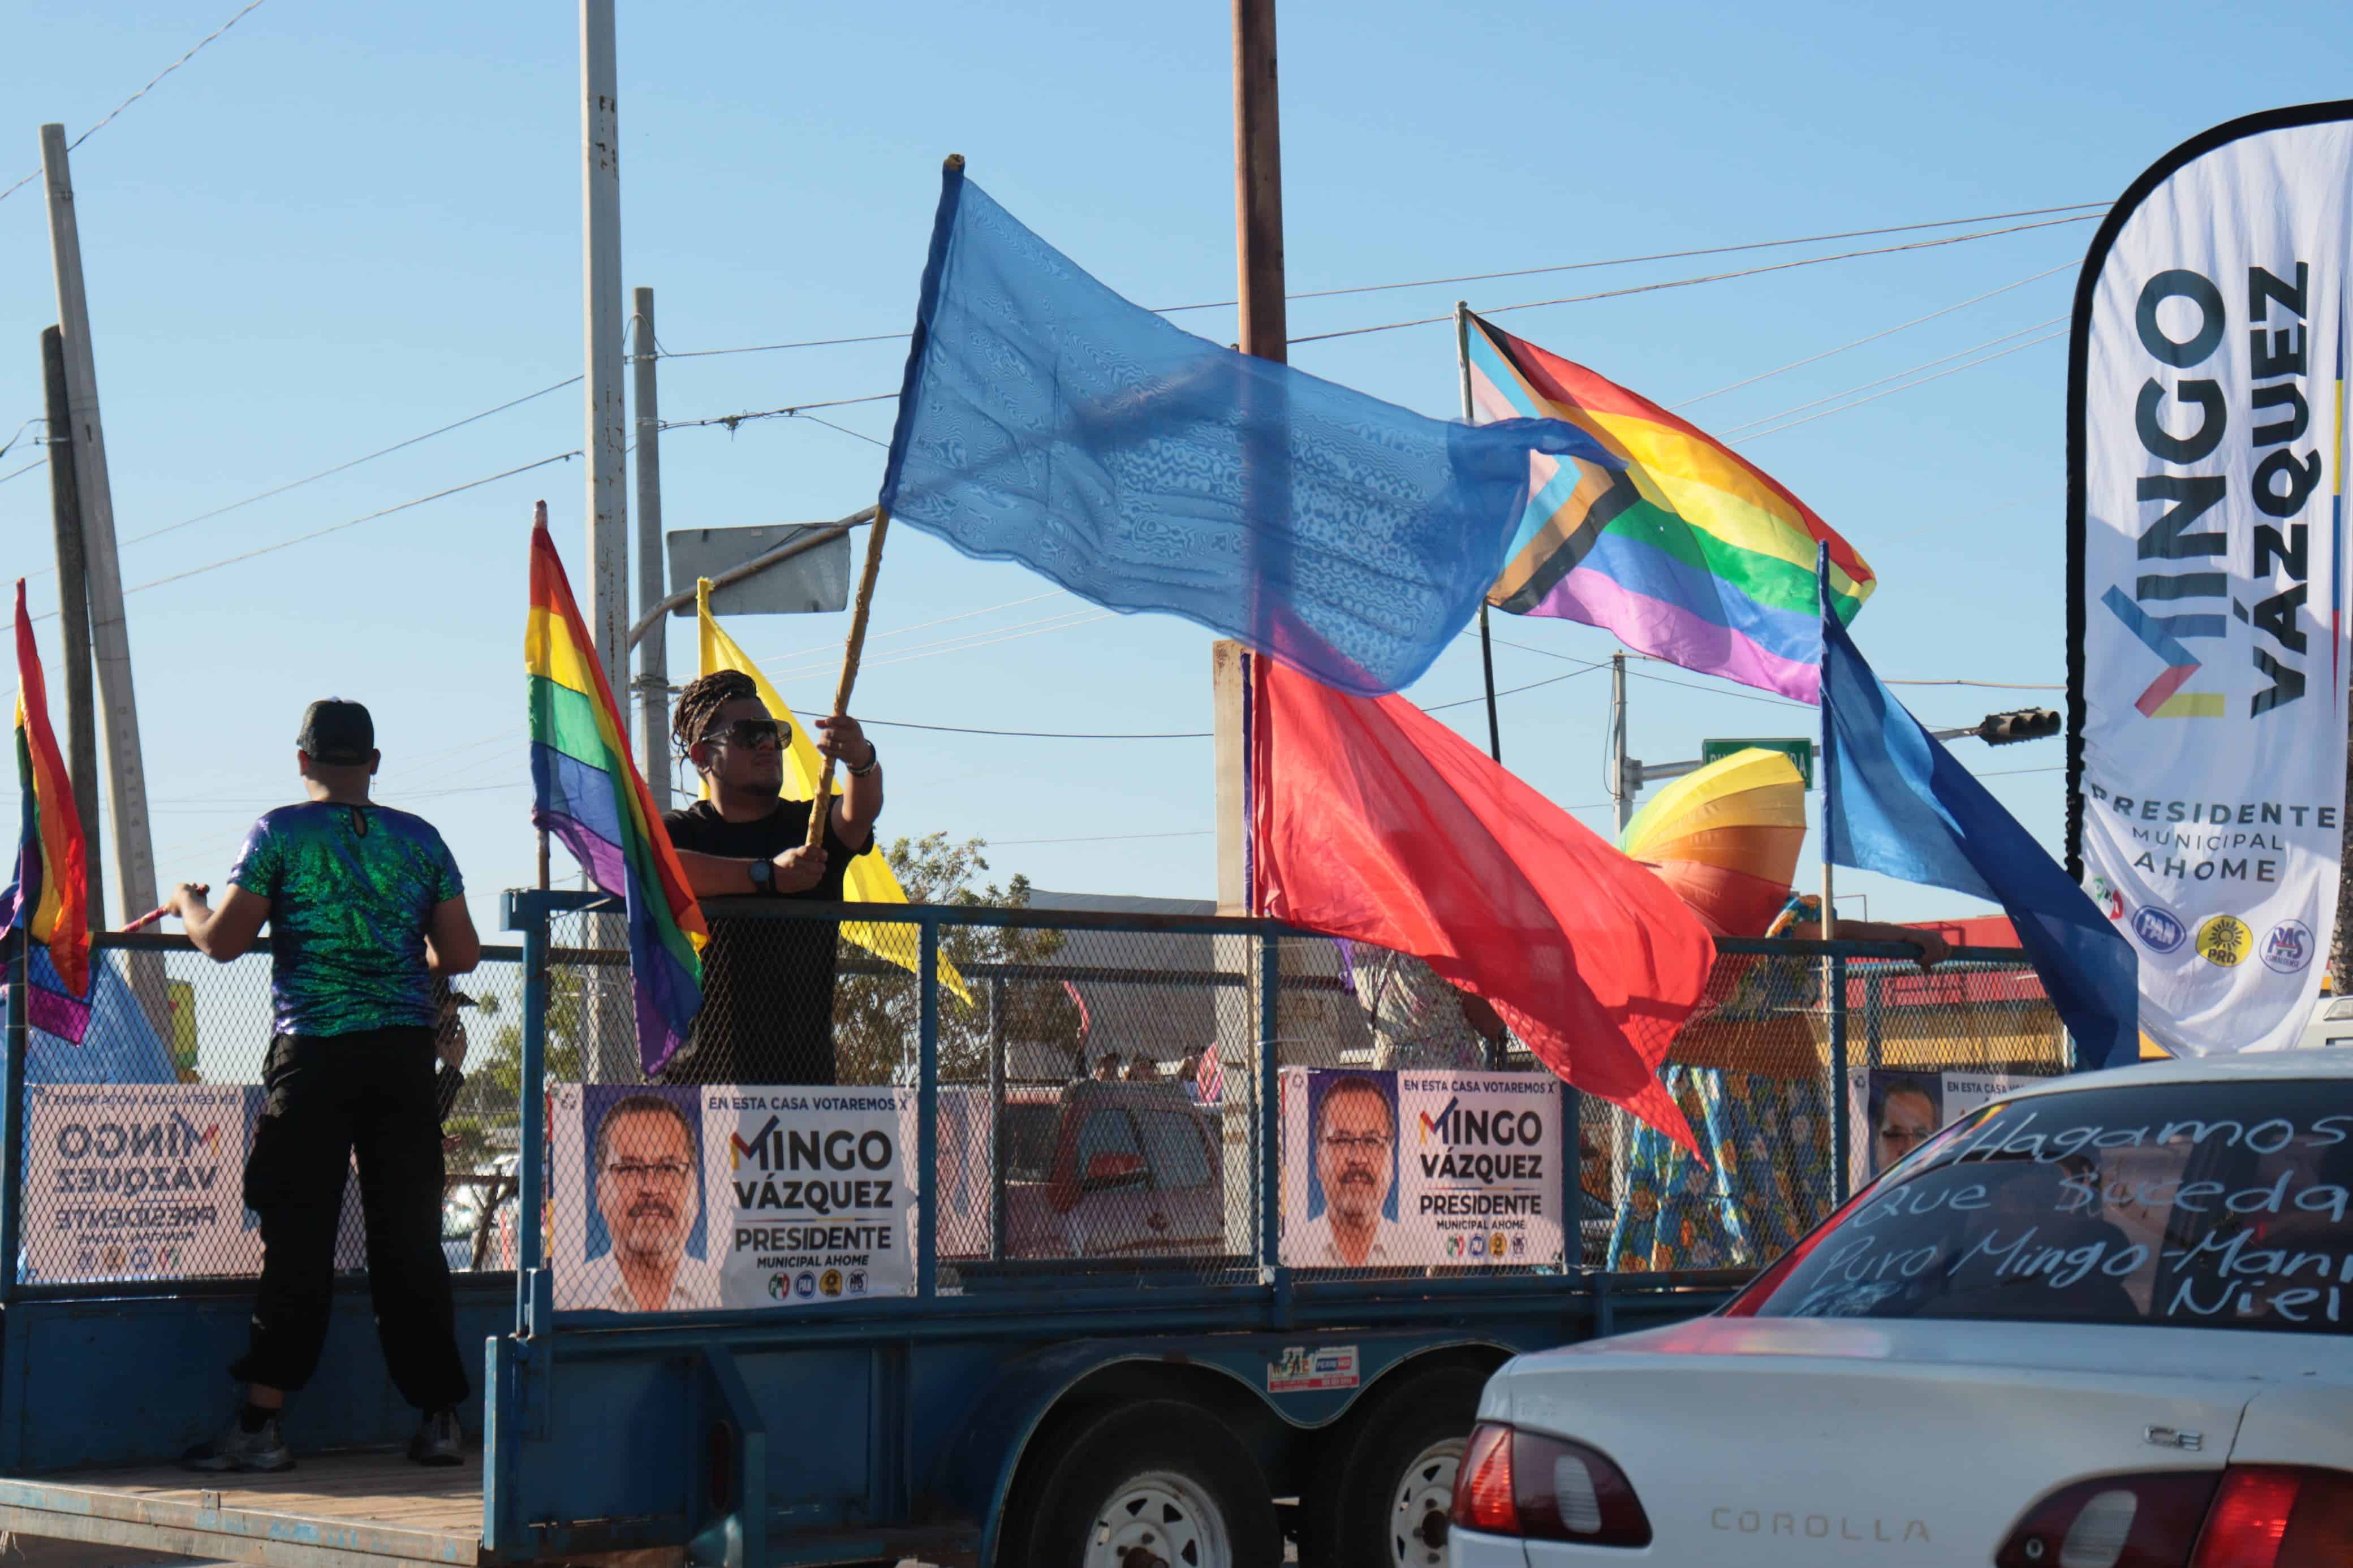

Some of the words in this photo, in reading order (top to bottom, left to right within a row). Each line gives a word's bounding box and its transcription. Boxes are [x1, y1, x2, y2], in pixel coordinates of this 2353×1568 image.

[2101, 269, 2227, 718] MINGO
[2233, 261, 2321, 719] VÁZQUEZ
[2092, 784, 2336, 828] PRESIDENTE
[2132, 827, 2283, 850] MUNICIPAL
[2134, 851, 2276, 883] AHOME
[2141, 913, 2175, 946] PAN
[2208, 948, 2236, 964] PRD
[1403, 1080, 1419, 1091] EN
[1422, 1080, 1448, 1091] ESTA
[1451, 1081, 1481, 1092] CASA
[1483, 1082, 1545, 1094] VOTAREMOS
[1947, 1082, 1959, 1092] EN
[1962, 1082, 1981, 1093] ESTA
[1984, 1083, 2007, 1094] CASA
[709, 1097, 729, 1109] EN
[733, 1097, 767, 1109] ESTA
[771, 1097, 809, 1110] CASA
[813, 1098, 895, 1111] VOTAREMOS
[1420, 1096, 1542, 1147] MINGO
[730, 1115, 893, 1171] MINGO
[1420, 1148, 1542, 1183] VÁZQUEZ
[733, 1173, 893, 1215] VÁZQUEZ
[1420, 1195, 1541, 1215] PRESIDENTE
[735, 1226, 892, 1252] PRESIDENTE
[1437, 1220, 1489, 1231] MUNICIPAL
[1492, 1220, 1525, 1230] AHOME
[757, 1256, 822, 1268] MUNICIPAL
[824, 1254, 869, 1267] AHOME
[1710, 1506, 1930, 1543] COROLLA
